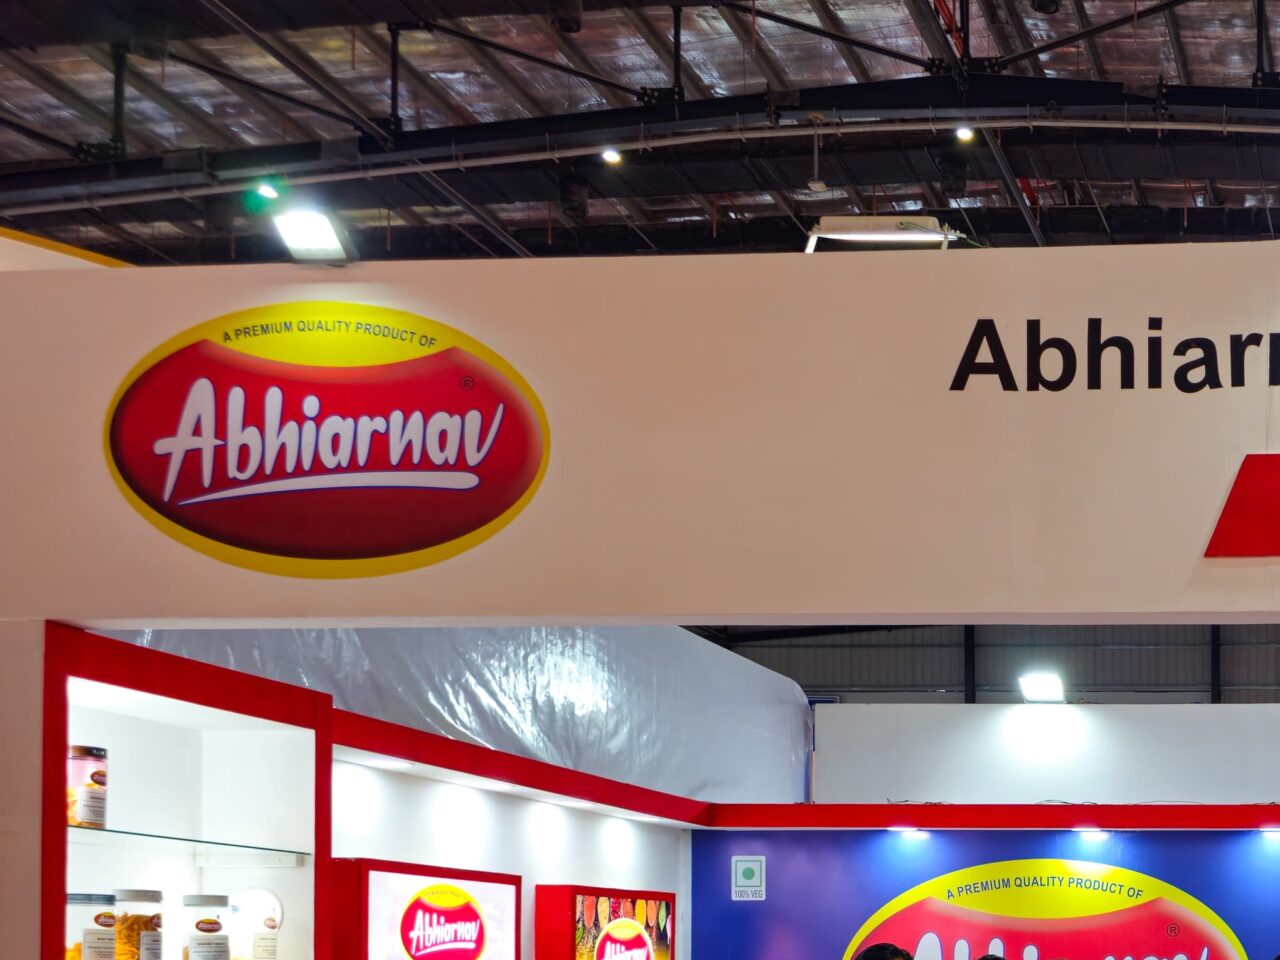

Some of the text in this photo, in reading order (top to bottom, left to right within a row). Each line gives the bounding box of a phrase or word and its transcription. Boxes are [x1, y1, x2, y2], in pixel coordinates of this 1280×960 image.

[223, 320, 437, 348] A PREMIUM QUALITY PRODUCT OF
[153, 376, 503, 502] Abhiarnav
[734, 889, 763, 899] 100% VEG
[946, 876, 1143, 900] A PREMIUM QUALITY PRODUCT OF
[409, 909, 480, 956] Abhiarnav
